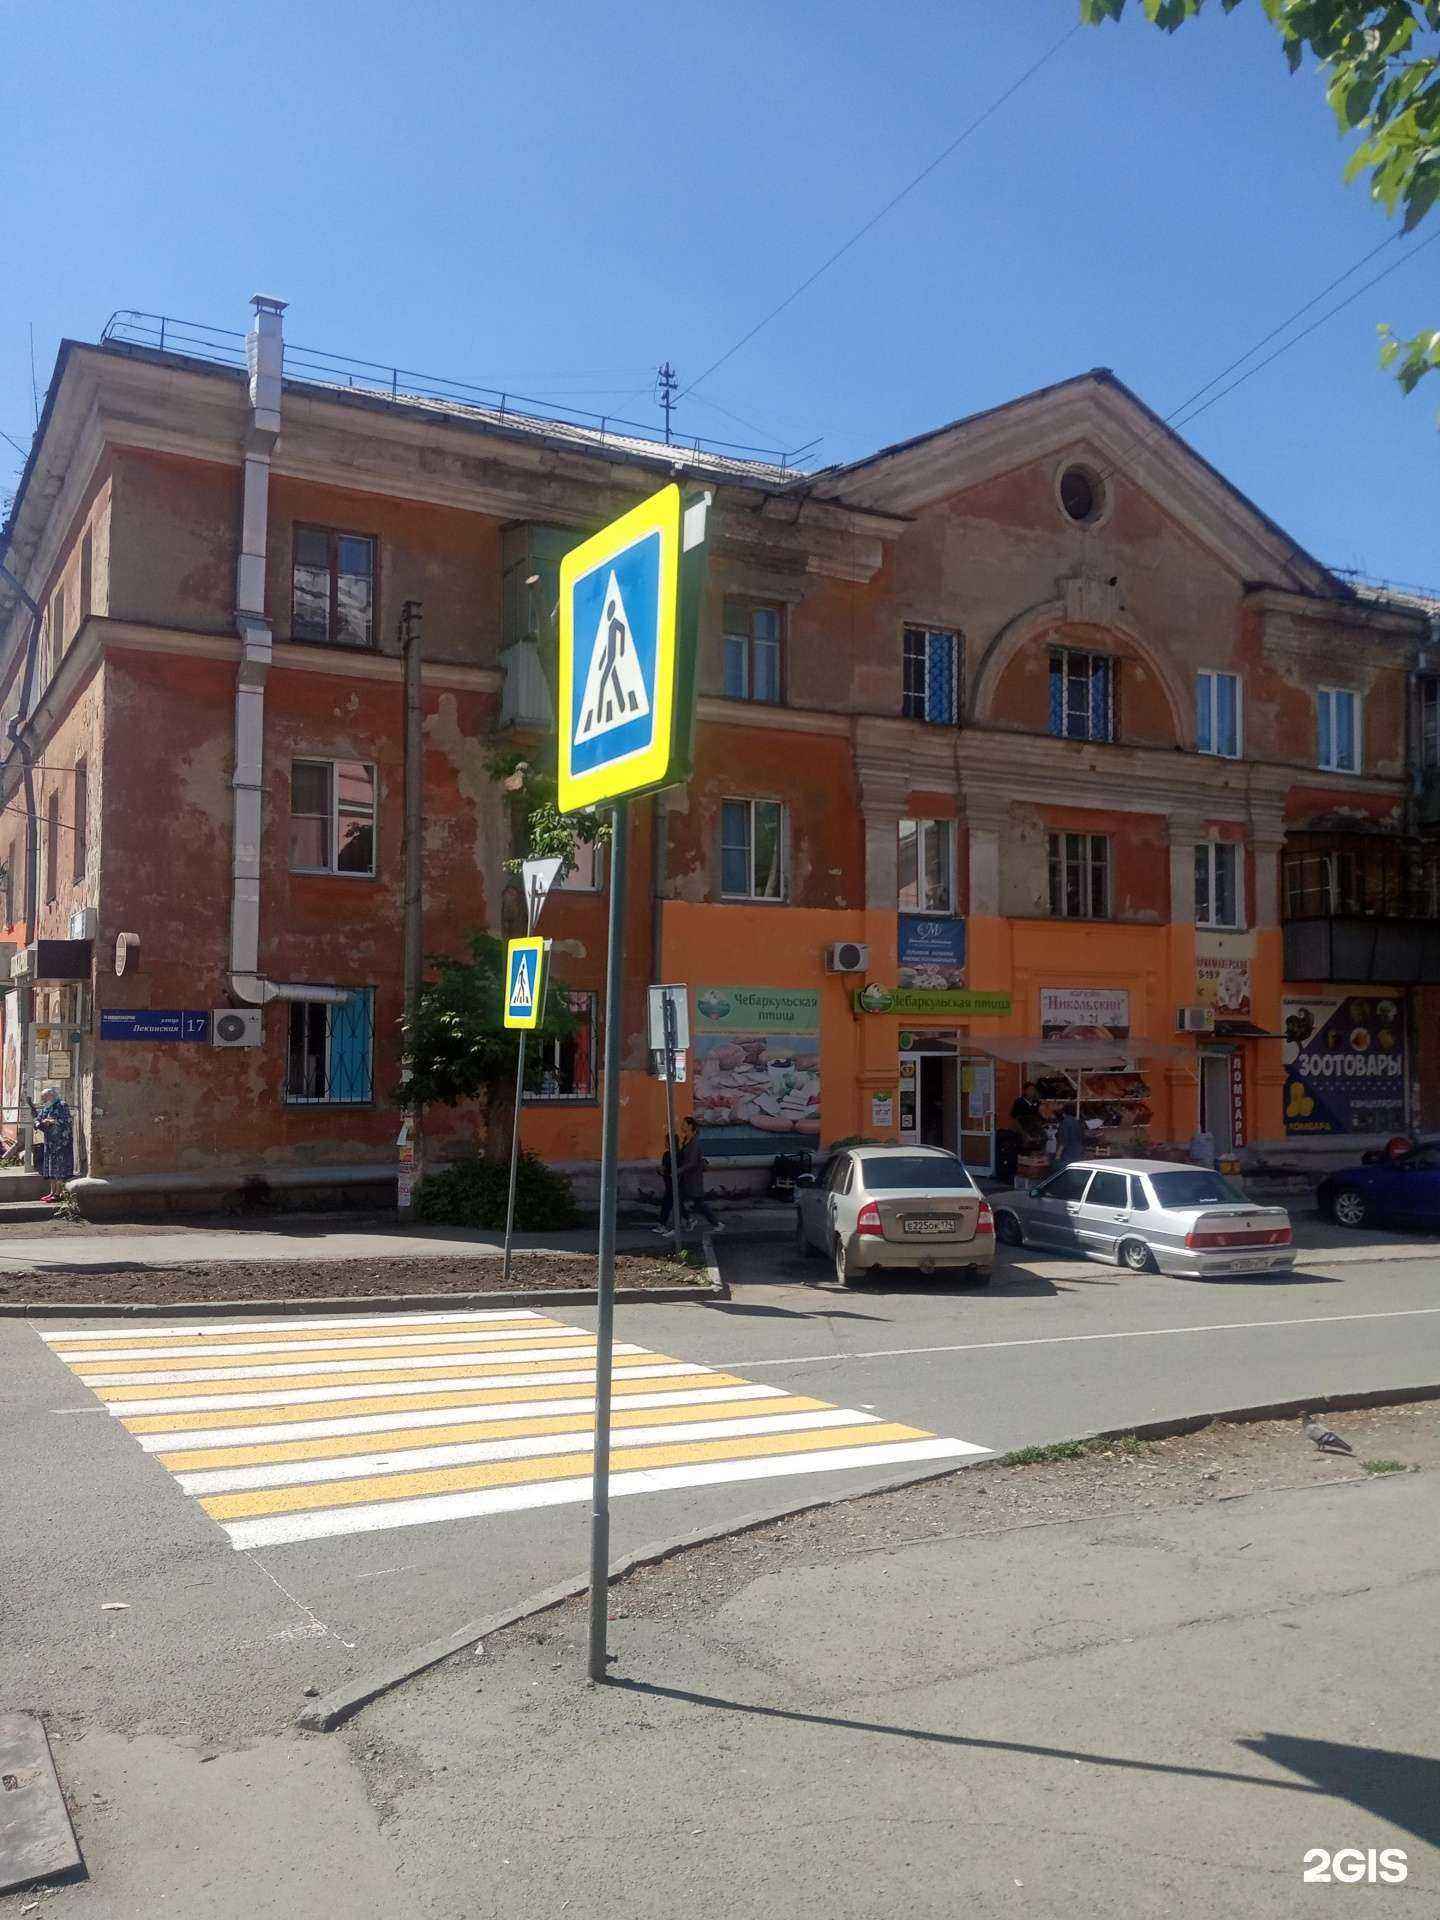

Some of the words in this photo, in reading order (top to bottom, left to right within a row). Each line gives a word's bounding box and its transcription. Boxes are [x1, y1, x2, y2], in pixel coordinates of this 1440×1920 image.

[734, 993, 817, 1009] Чебаркульская
[974, 999, 1010, 1009] птица
[759, 1011, 795, 1021] птица
[133, 1024, 179, 1032] Пекинская
[187, 1019, 205, 1032] 17
[1298, 1054, 1402, 1076] ЗООТОВАРЫ
